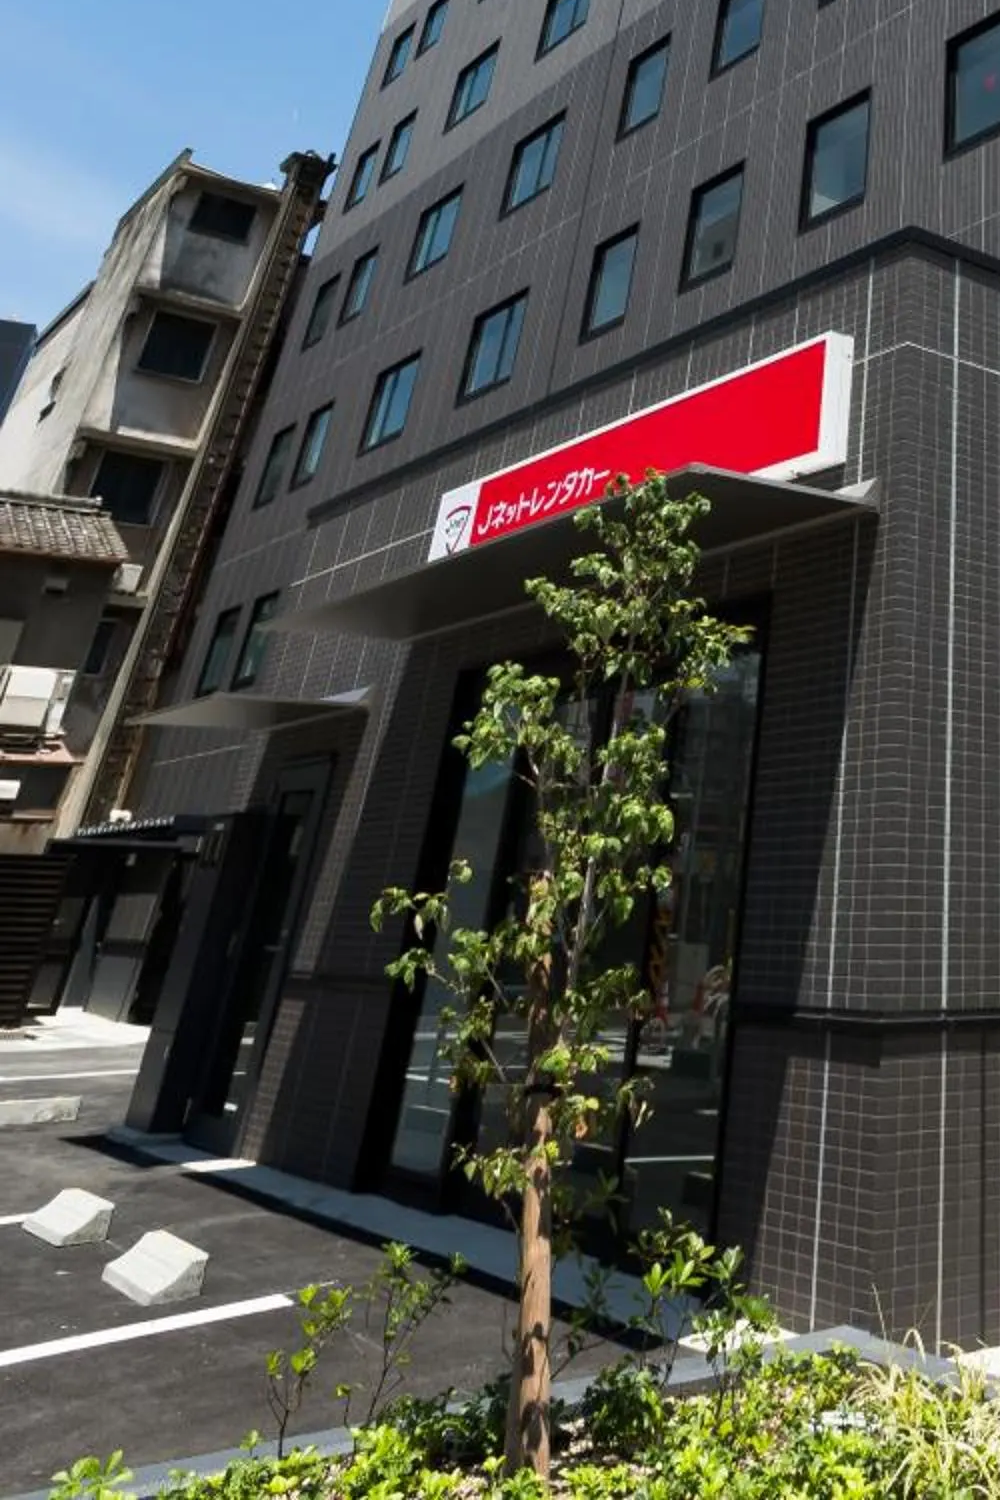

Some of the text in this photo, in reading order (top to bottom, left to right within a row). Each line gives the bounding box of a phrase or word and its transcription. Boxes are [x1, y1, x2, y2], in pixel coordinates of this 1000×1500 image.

[478, 468, 610, 535] Jネットレンタカー
